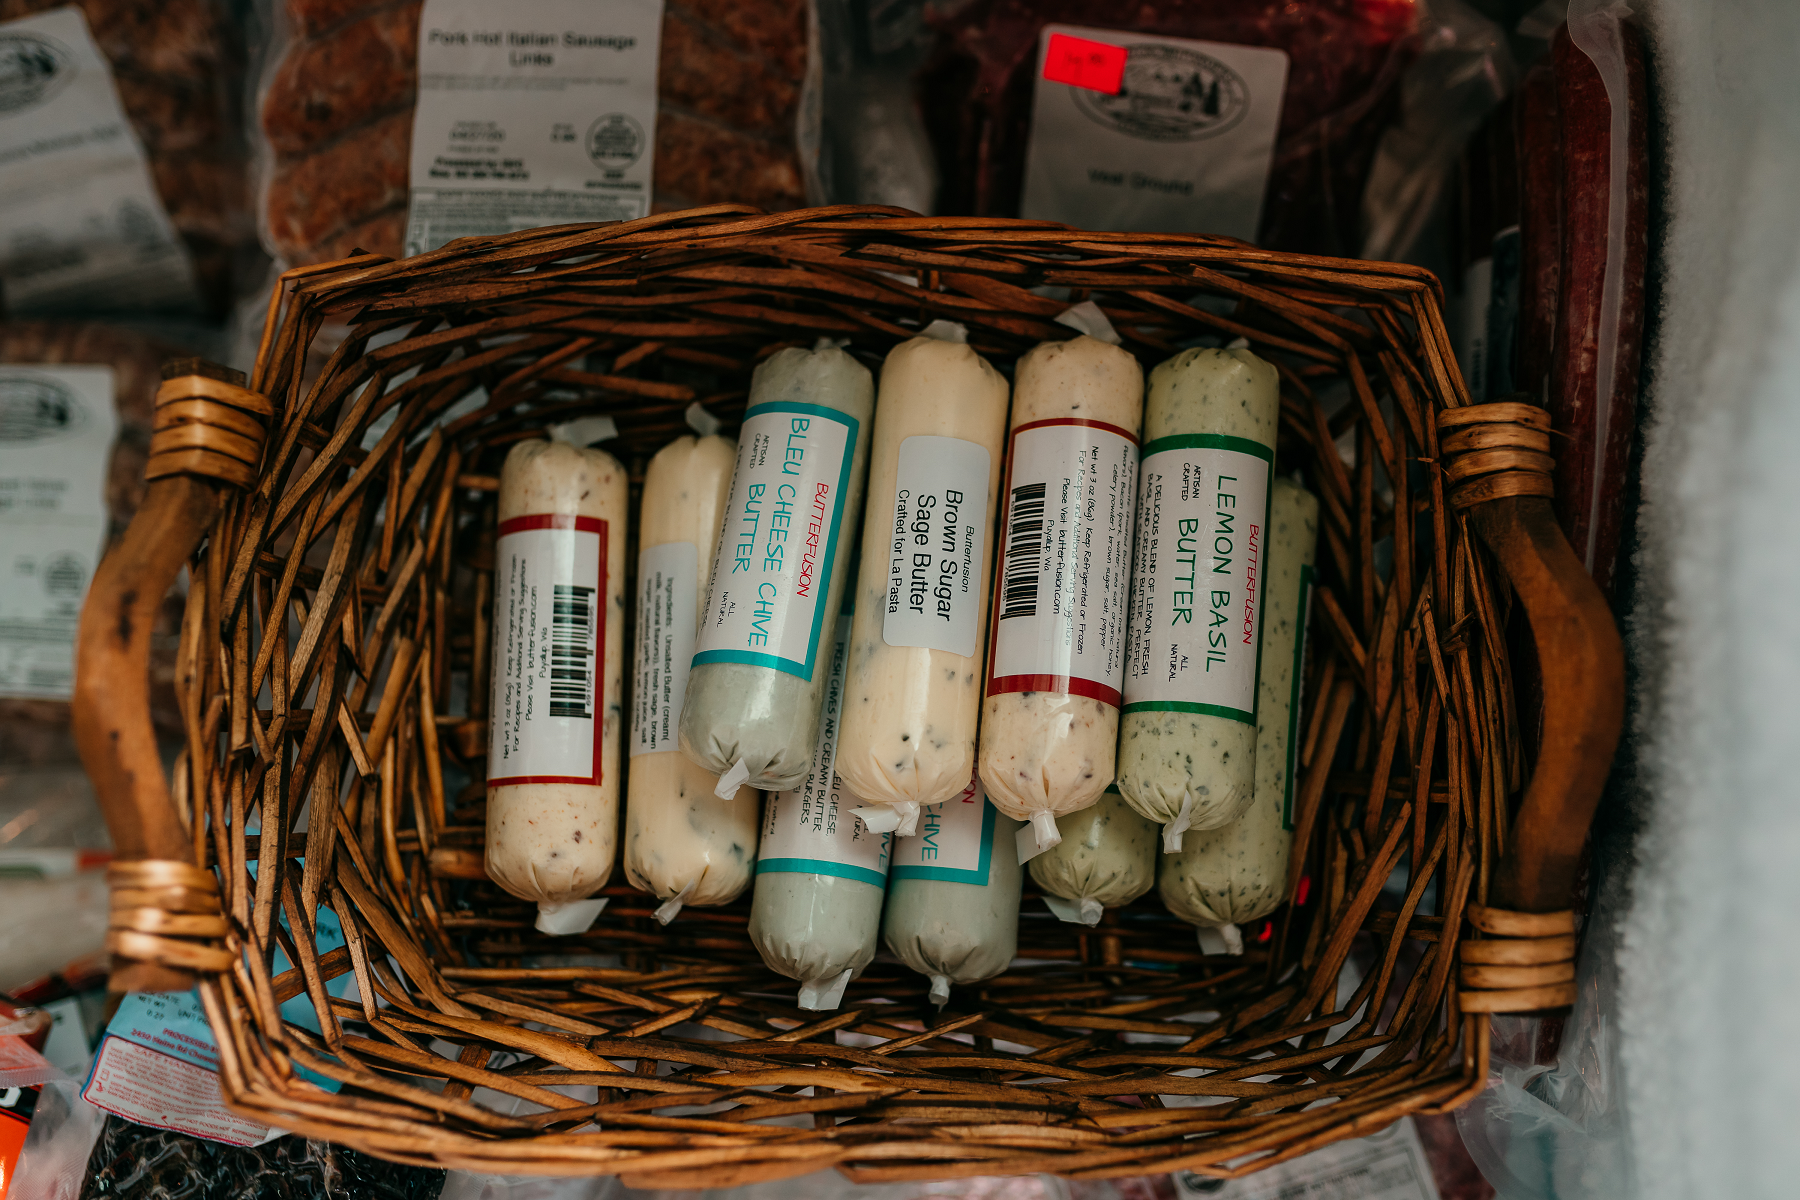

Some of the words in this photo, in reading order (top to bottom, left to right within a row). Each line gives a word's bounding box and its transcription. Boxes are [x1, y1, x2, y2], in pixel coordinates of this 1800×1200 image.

[428, 29, 469, 46] Pork
[507, 31, 558, 47] Italian
[562, 31, 638, 52] Sausage
[509, 51, 555, 66] Links
[749, 433, 761, 469] CRAFTED
[758, 435, 770, 466] ARTISAN
[781, 418, 810, 475] BLEU
[1073, 469, 1085, 500] Recipes
[1090, 464, 1097, 474] wt
[1110, 464, 1118, 492] celery
[1181, 463, 1191, 501] CRAFTED
[1192, 465, 1201, 498] ARTISAN
[1061, 478, 1070, 504] Please
[1088, 485, 1095, 495] oz
[721, 504, 732, 538] BLEND
[895, 489, 910, 534] Crafted
[911, 494, 936, 545] Sage
[942, 489, 963, 553] Brown
[1060, 507, 1068, 524] Visit
[1084, 499, 1096, 521] (86g)
[1152, 485, 1162, 535] DELICIOUS
[1212, 475, 1237, 575] LEMON
[732, 483, 765, 574] BUTTER
[763, 484, 796, 572] CHEESE
[797, 483, 829, 598] BUTTERFUSION
[894, 537, 905, 554] for
[1071, 521, 1081, 560] Additional
[1082, 528, 1093, 547] Keep
[892, 558, 903, 574] La
[961, 526, 975, 593] Butterfusion
[1044, 556, 1051, 571] Wa
[1140, 531, 1149, 573] CREAMY
[1149, 539, 1158, 574] BLEND
[710, 559, 720, 586] BLEU
[909, 553, 931, 614] Butter
[1066, 562, 1078, 594] Serving
[1079, 551, 1091, 607] Refrigerated
[1148, 578, 1155, 592] OF
[1172, 518, 1198, 626] BUTTER
[1243, 524, 1259, 644] BUTTERFUSION
[888, 578, 902, 613] Pasta
[934, 559, 958, 621] Sugar
[517, 608, 526, 639] Serving
[716, 591, 729, 627] NATURAL
[728, 601, 736, 617] ALL
[748, 582, 776, 647] CHIVE
[1064, 597, 1075, 646] Suggestions
[1080, 610, 1086, 620] or
[541, 627, 547, 642] Wa
[1077, 624, 1086, 655] Frozen
[1099, 618, 1107, 650] pepper
[1206, 590, 1231, 672] BASIL
[515, 642, 524, 679] Additional
[665, 635, 673, 673] Unsalted
[832, 642, 845, 676] FRESH
[1132, 629, 1141, 679] PERFECT
[1142, 639, 1150, 675] FRESH
[1169, 644, 1178, 682] NATURAL
[1181, 655, 1189, 671] ALL
[652, 668, 660, 691] fresh
[663, 676, 672, 703] Butter
[827, 679, 841, 715] CHIVES
[514, 700, 522, 732] Recipes
[526, 694, 534, 721] Please
[650, 721, 658, 749] brown
[824, 717, 833, 739] AND
[818, 742, 832, 787] CREAMY
[799, 774, 814, 826] BURGERS,
[812, 789, 826, 833] BUTTER
[826, 794, 839, 837] CHEESE,
[853, 805, 862, 842] NTURAL
[922, 802, 943, 861] CHIVE
[879, 831, 891, 868] IVE
[162, 1028, 209, 1050] PROCESSED
